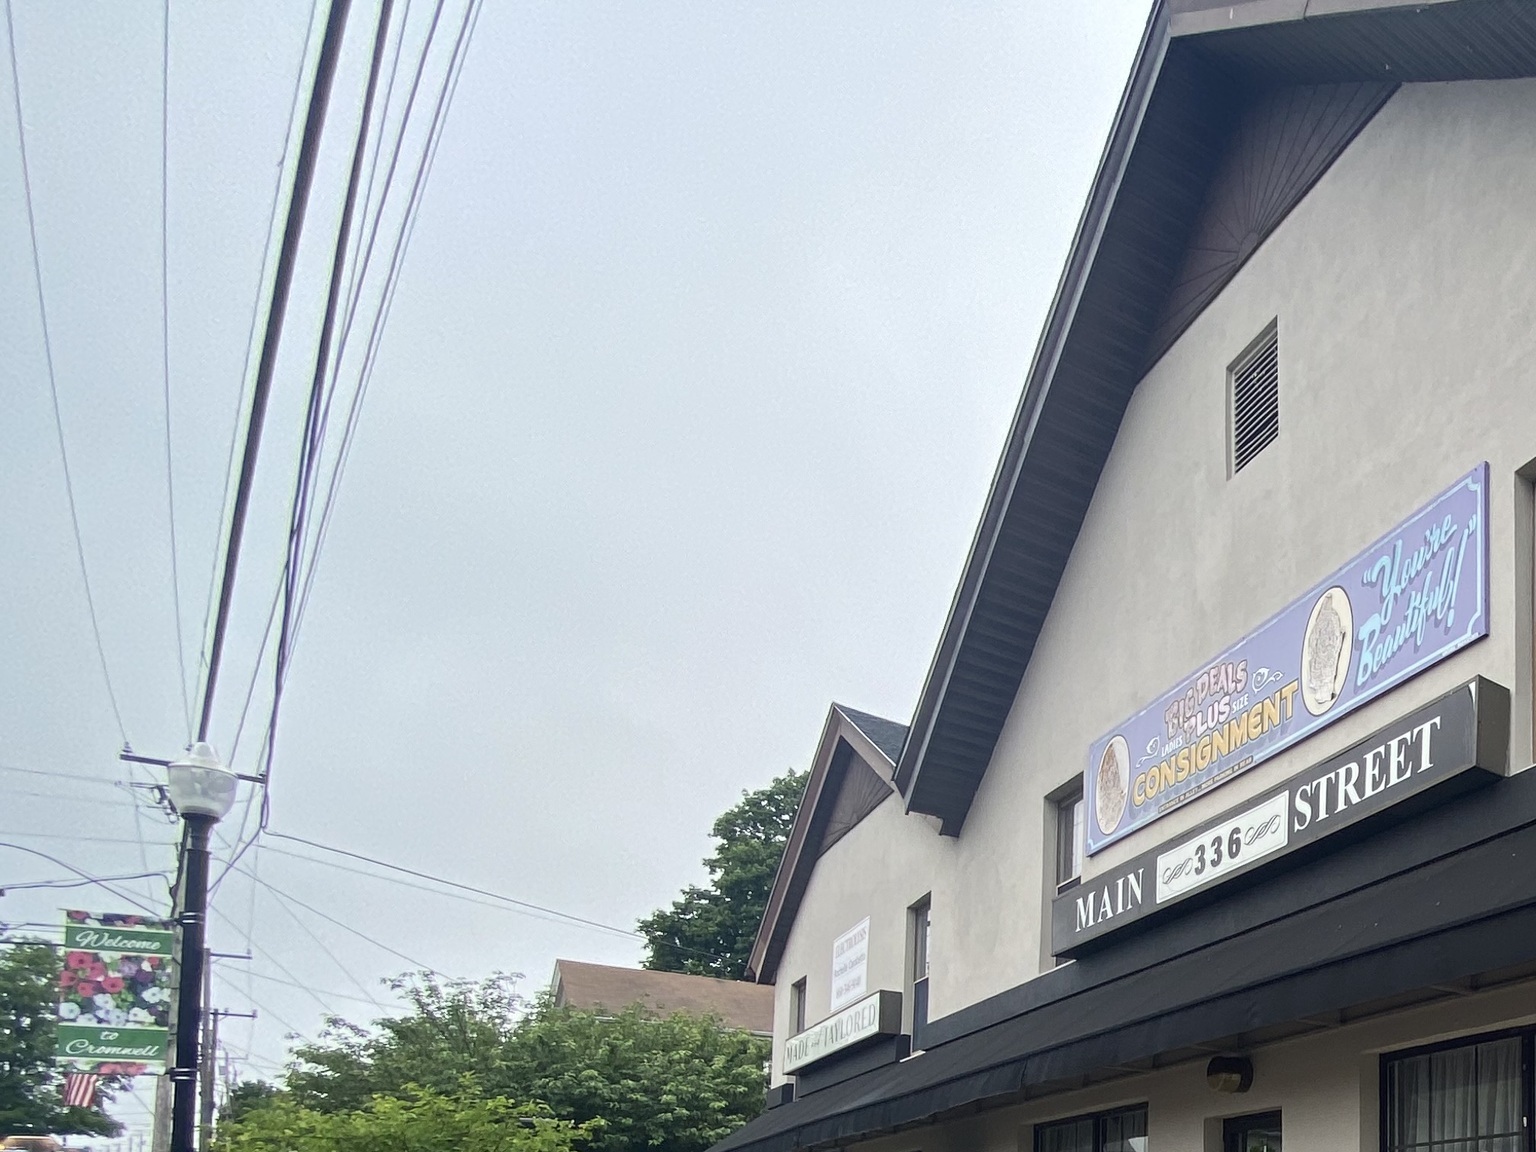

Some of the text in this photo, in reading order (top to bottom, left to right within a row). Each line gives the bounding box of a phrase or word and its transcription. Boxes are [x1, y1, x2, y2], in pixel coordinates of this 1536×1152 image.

[1161, 694, 1249, 757] LADIES PLUS SIZE
[1165, 660, 1249, 741] BIG DEALS
[1132, 679, 1299, 807] CONSIGNMENT
[1075, 716, 1442, 933] MAIN 336 STREET
[75, 930, 162, 951] Welcome
[66, 1039, 160, 1057] Cromwell
[100, 1031, 119, 1041] to
[787, 1036, 811, 1064] MADE
[822, 1003, 876, 1048] TAYLORED
